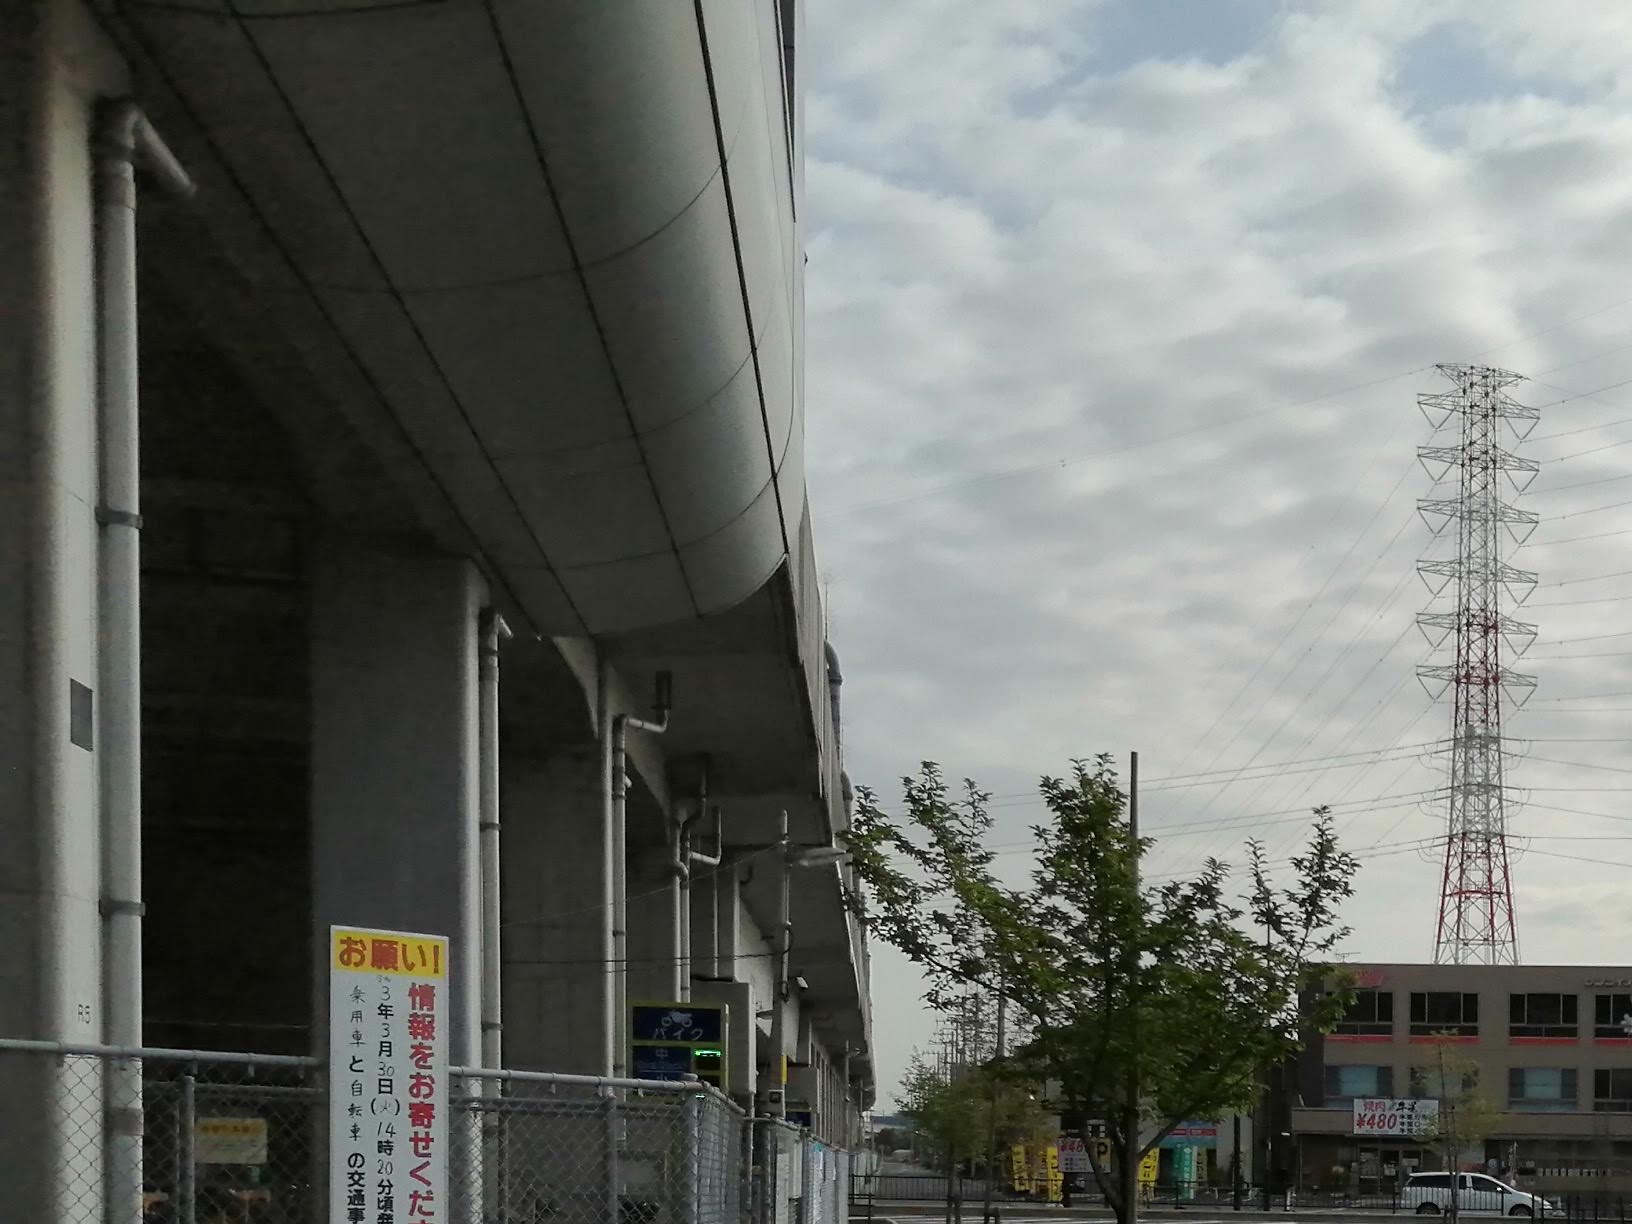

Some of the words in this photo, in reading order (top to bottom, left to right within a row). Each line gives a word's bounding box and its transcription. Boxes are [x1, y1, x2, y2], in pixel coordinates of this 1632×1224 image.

[339, 936, 441, 974] お願い!
[653, 1027, 704, 1041] バイク
[1356, 1113, 1398, 1129] ¥480
